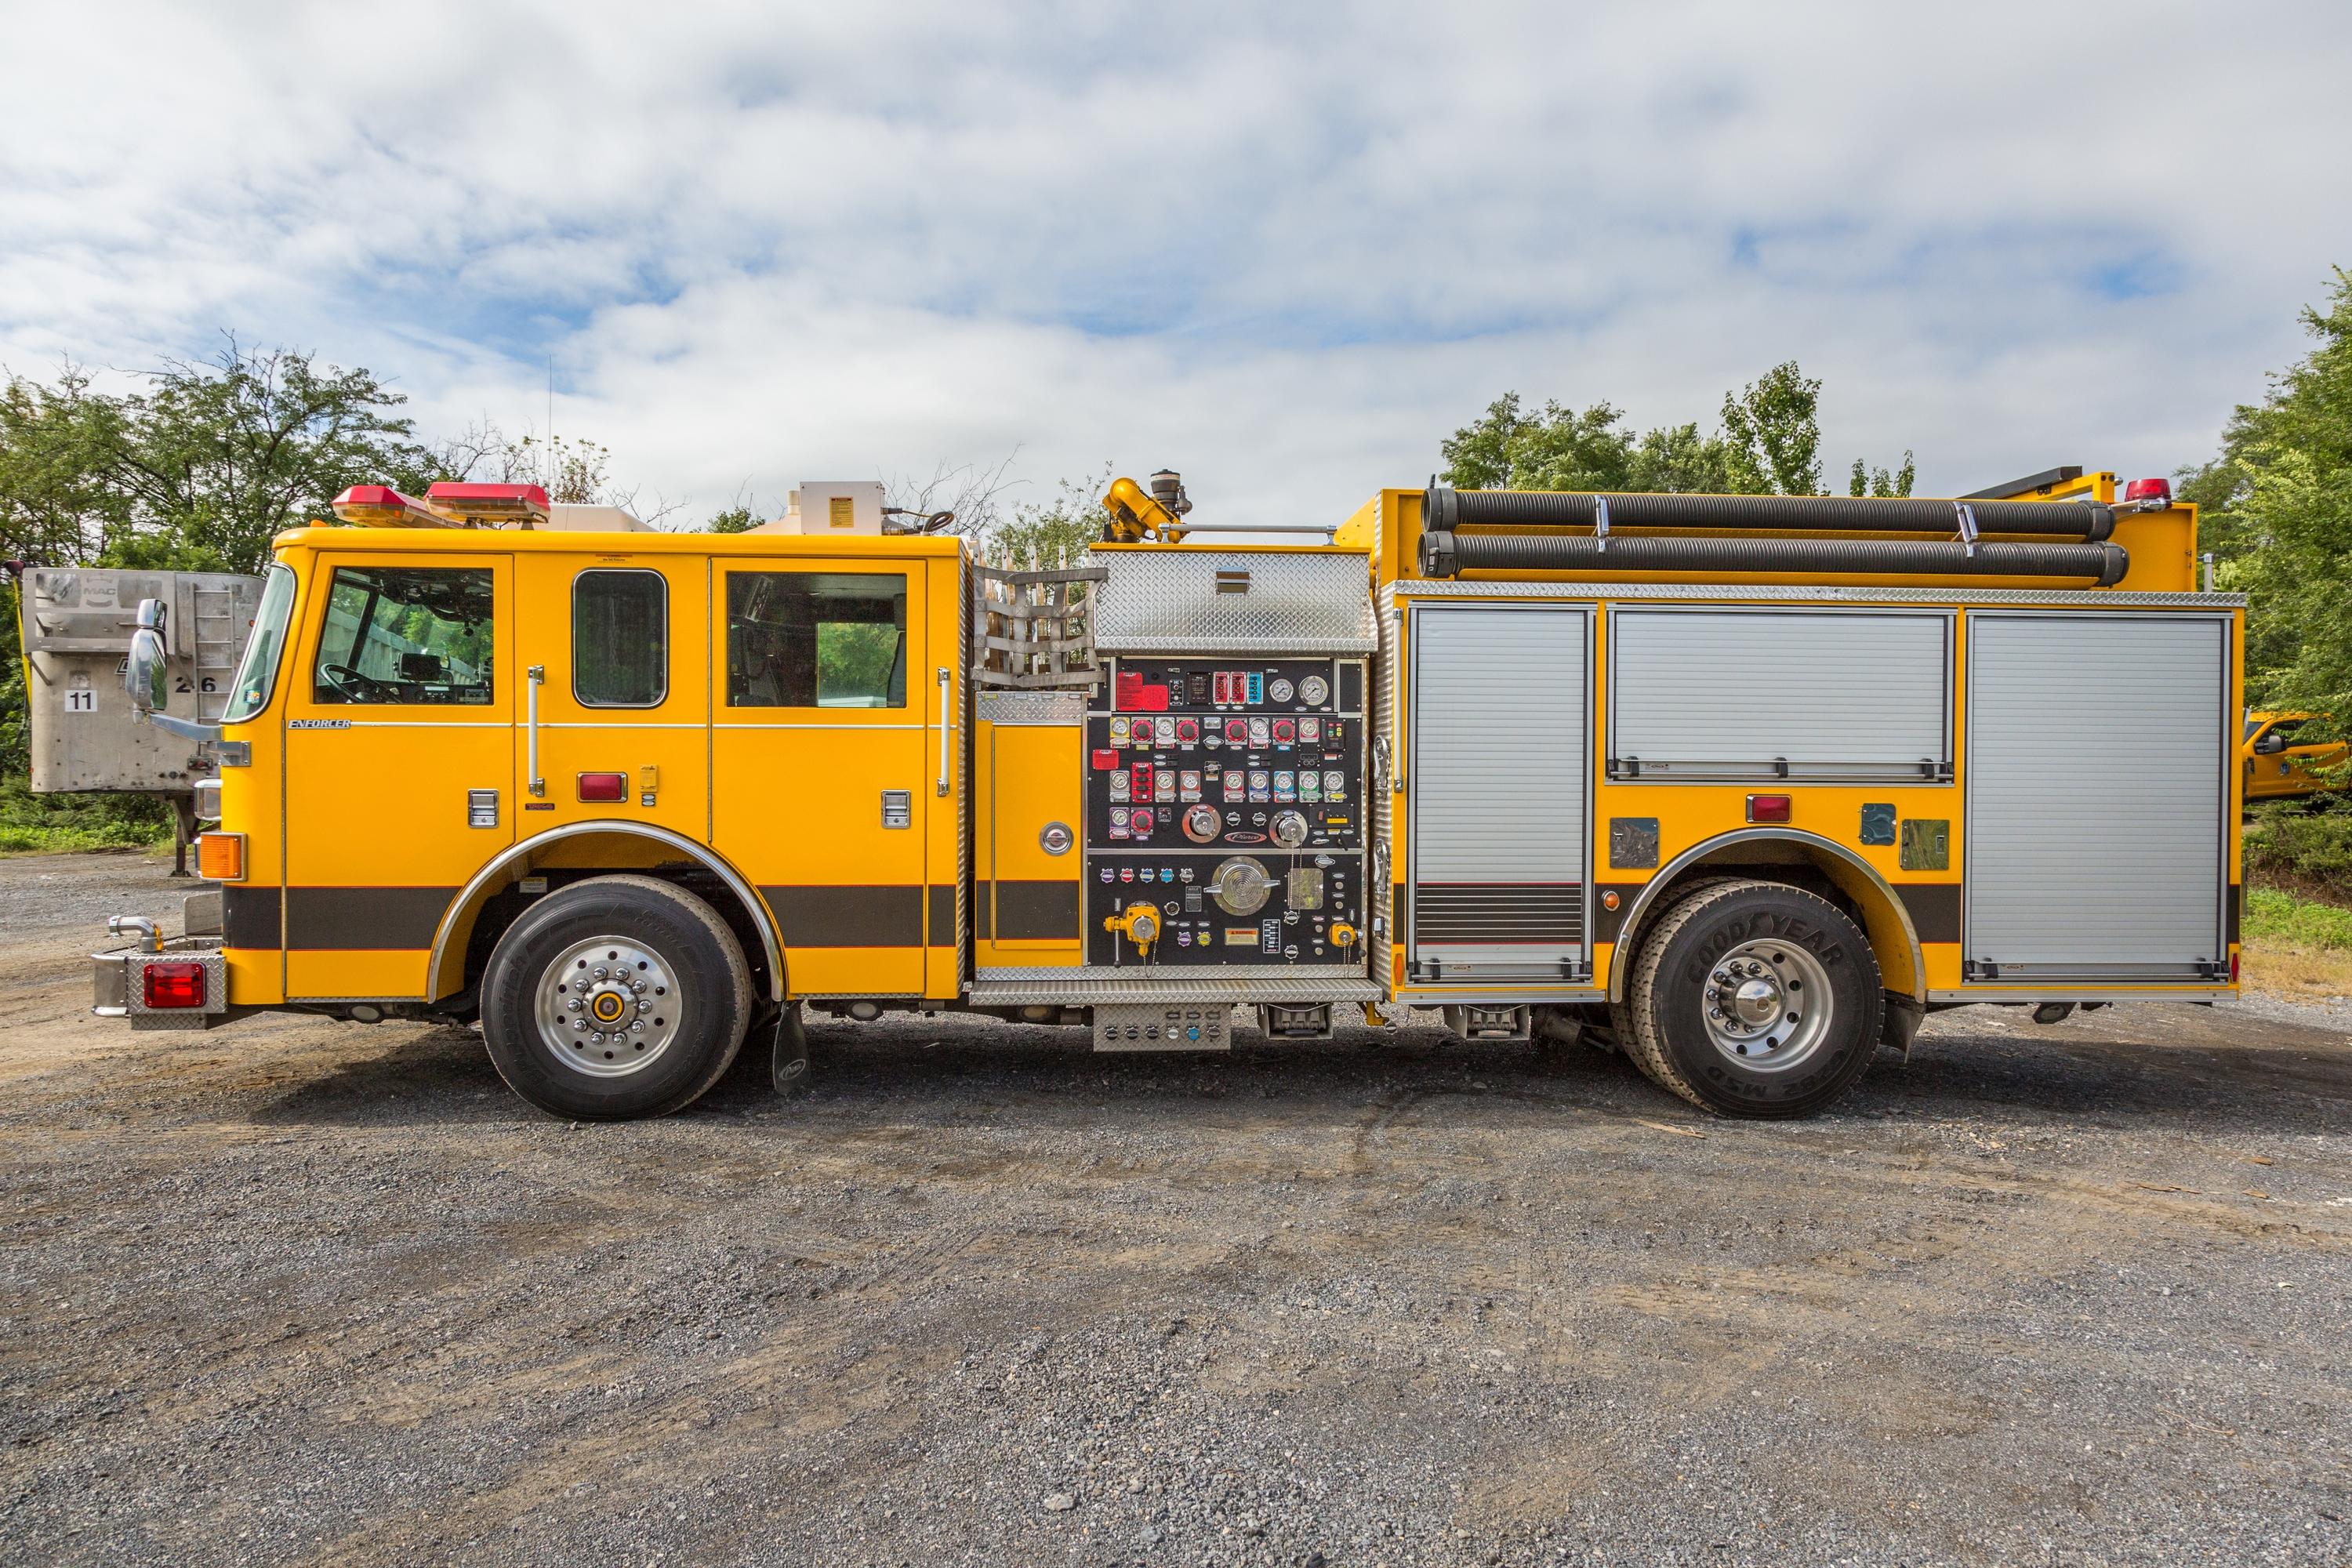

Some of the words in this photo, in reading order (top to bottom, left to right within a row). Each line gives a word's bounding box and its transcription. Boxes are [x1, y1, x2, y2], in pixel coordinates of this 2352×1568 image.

[70, 692, 91, 710] 11
[289, 719, 351, 729] ENFORCER
[1687, 913, 1844, 983] GOODYEAR
